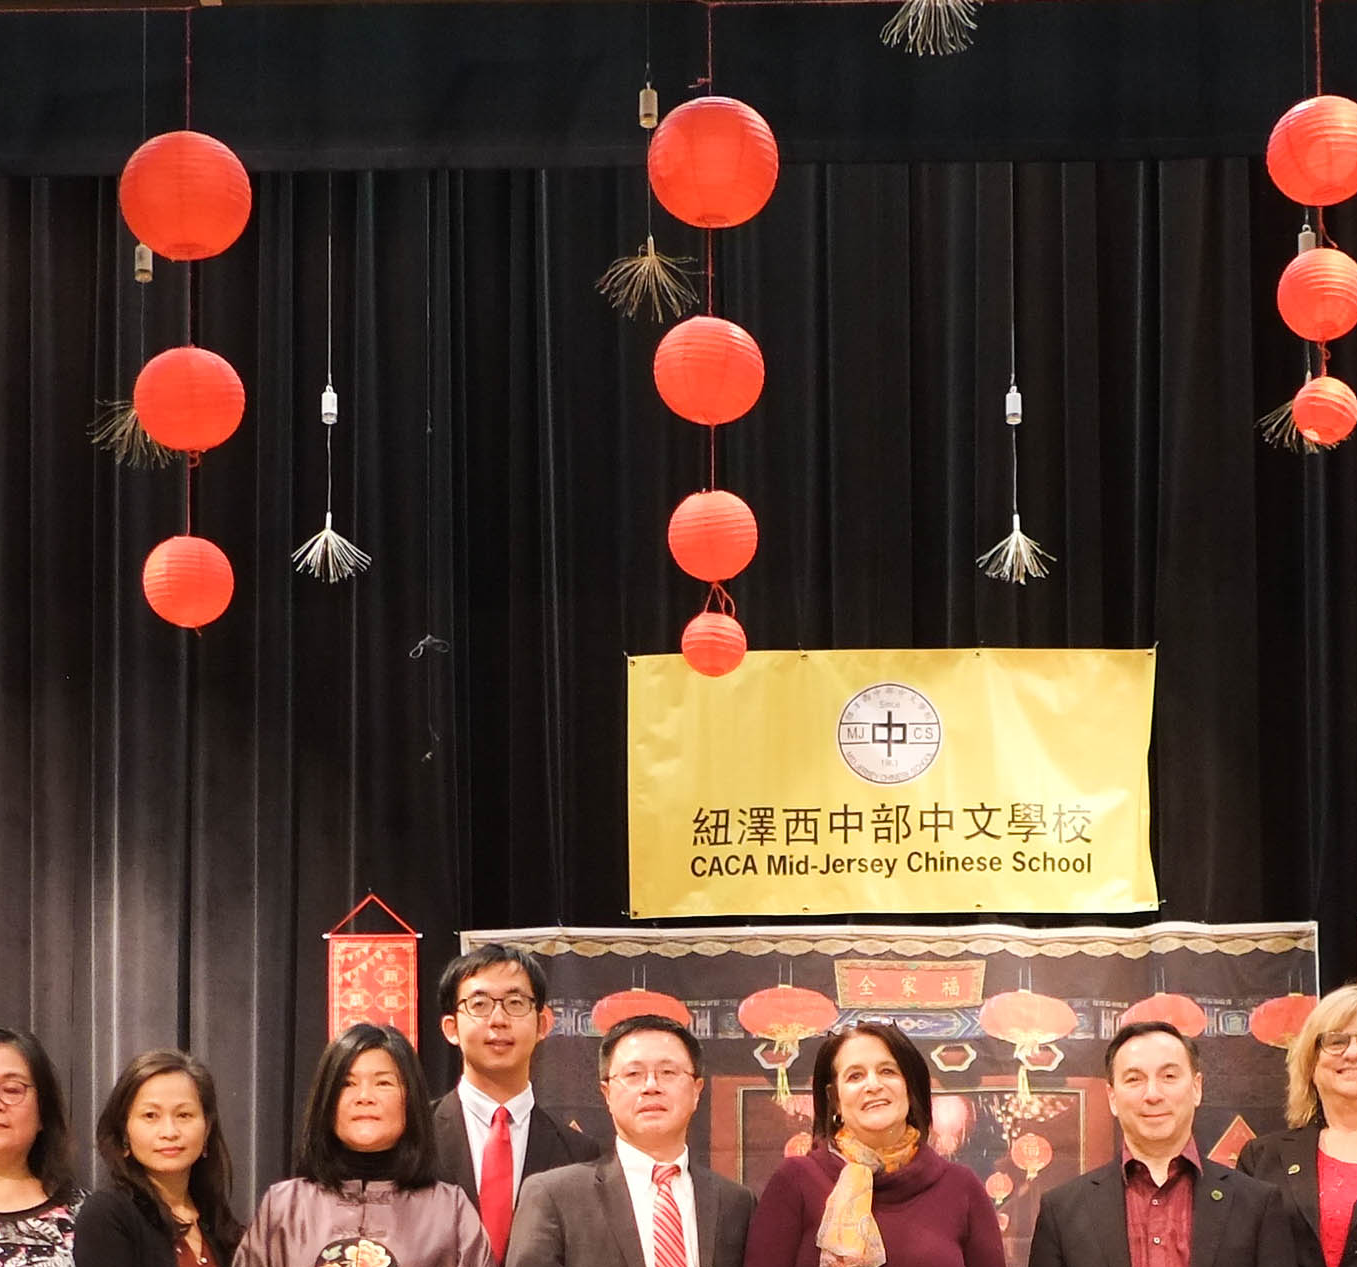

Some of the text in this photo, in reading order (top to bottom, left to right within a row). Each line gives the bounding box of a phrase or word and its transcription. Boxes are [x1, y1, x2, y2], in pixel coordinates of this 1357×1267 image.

[847, 710, 934, 757] MJ 中 CS
[692, 802, 1092, 847] 紐澤西中部中文學校
[690, 851, 1092, 879] CACA Mid-Jersey Chinese School
[858, 975, 961, 998] 全家福
